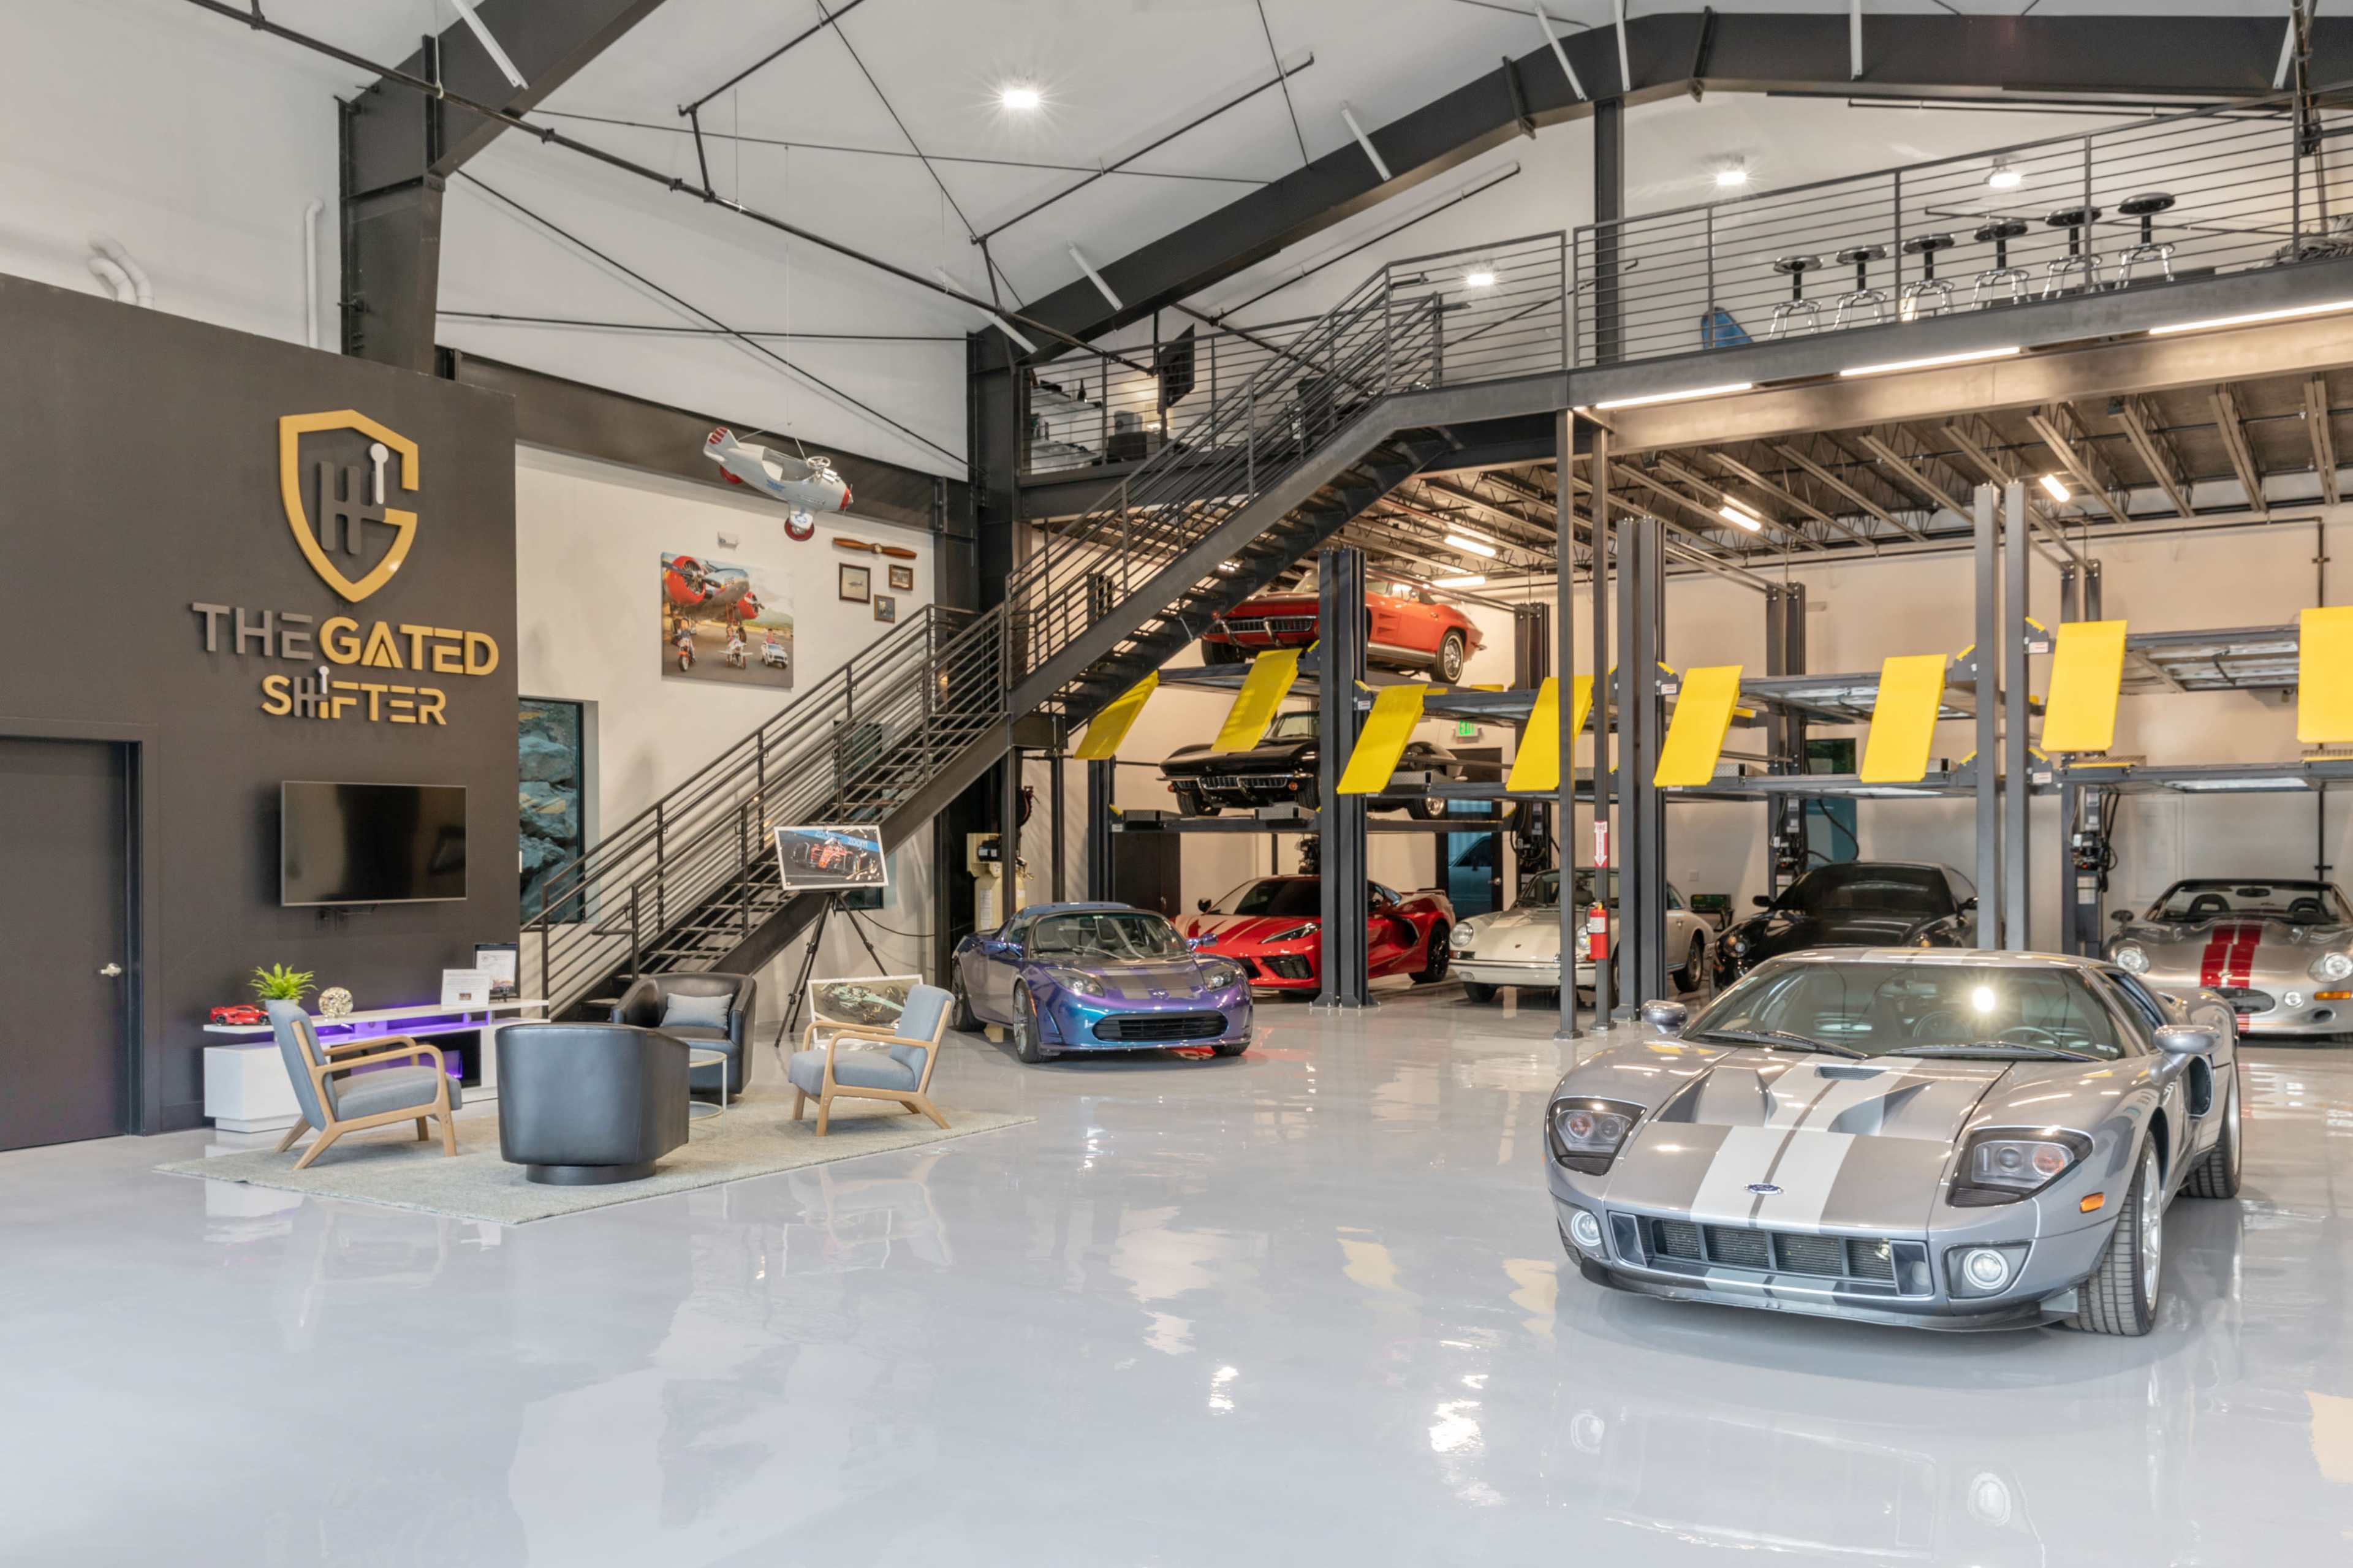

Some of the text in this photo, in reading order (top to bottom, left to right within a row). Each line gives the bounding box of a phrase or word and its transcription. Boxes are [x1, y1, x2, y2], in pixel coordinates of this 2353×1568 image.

[192, 602, 499, 676] THE GATED
[262, 665, 447, 725] SHIFTER
[847, 836, 868, 849] zoom
